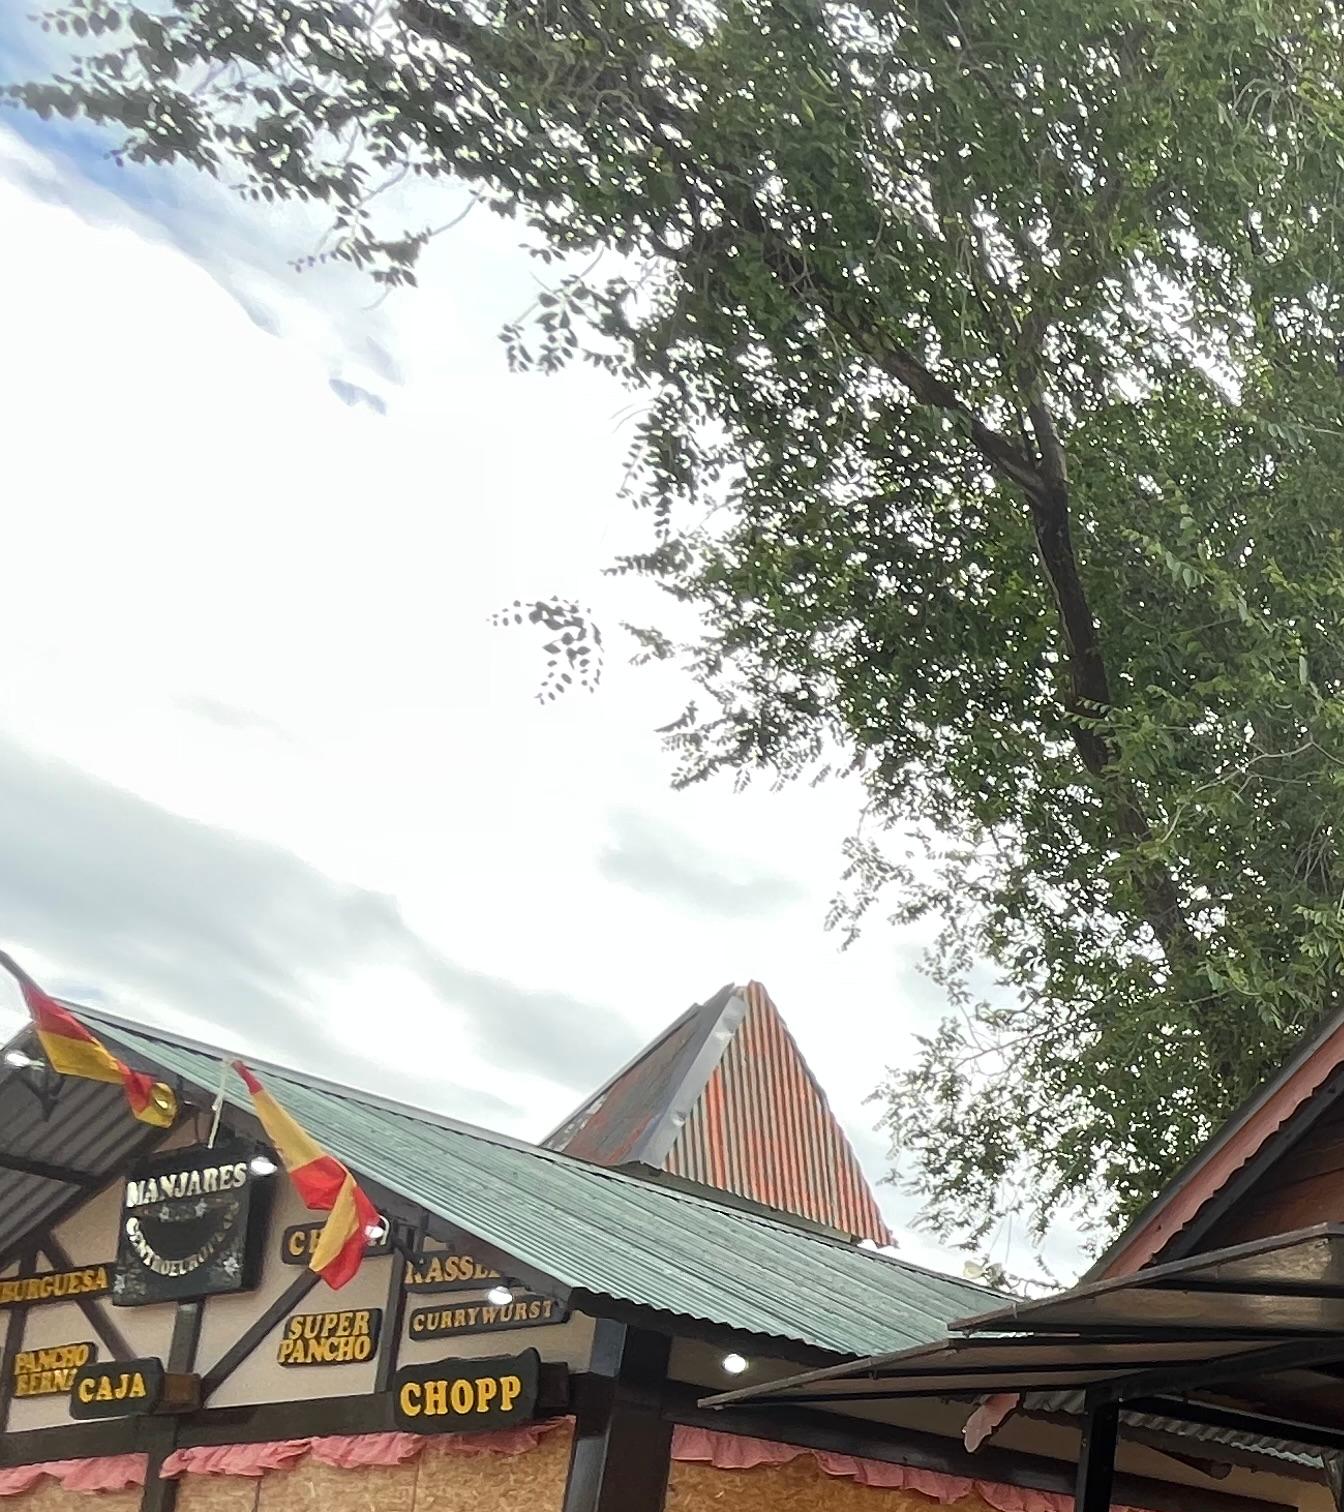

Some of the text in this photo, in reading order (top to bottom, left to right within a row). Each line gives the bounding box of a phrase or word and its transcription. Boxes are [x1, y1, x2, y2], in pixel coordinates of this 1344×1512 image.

[126, 1162, 248, 1208] MANJARES
[288, 1311, 369, 1339] SUPER
[413, 1300, 553, 1332] CURRYWURST
[278, 1336, 372, 1364] PANCHO
[78, 1372, 147, 1403] CAJA
[400, 1375, 522, 1416] CHOPP
